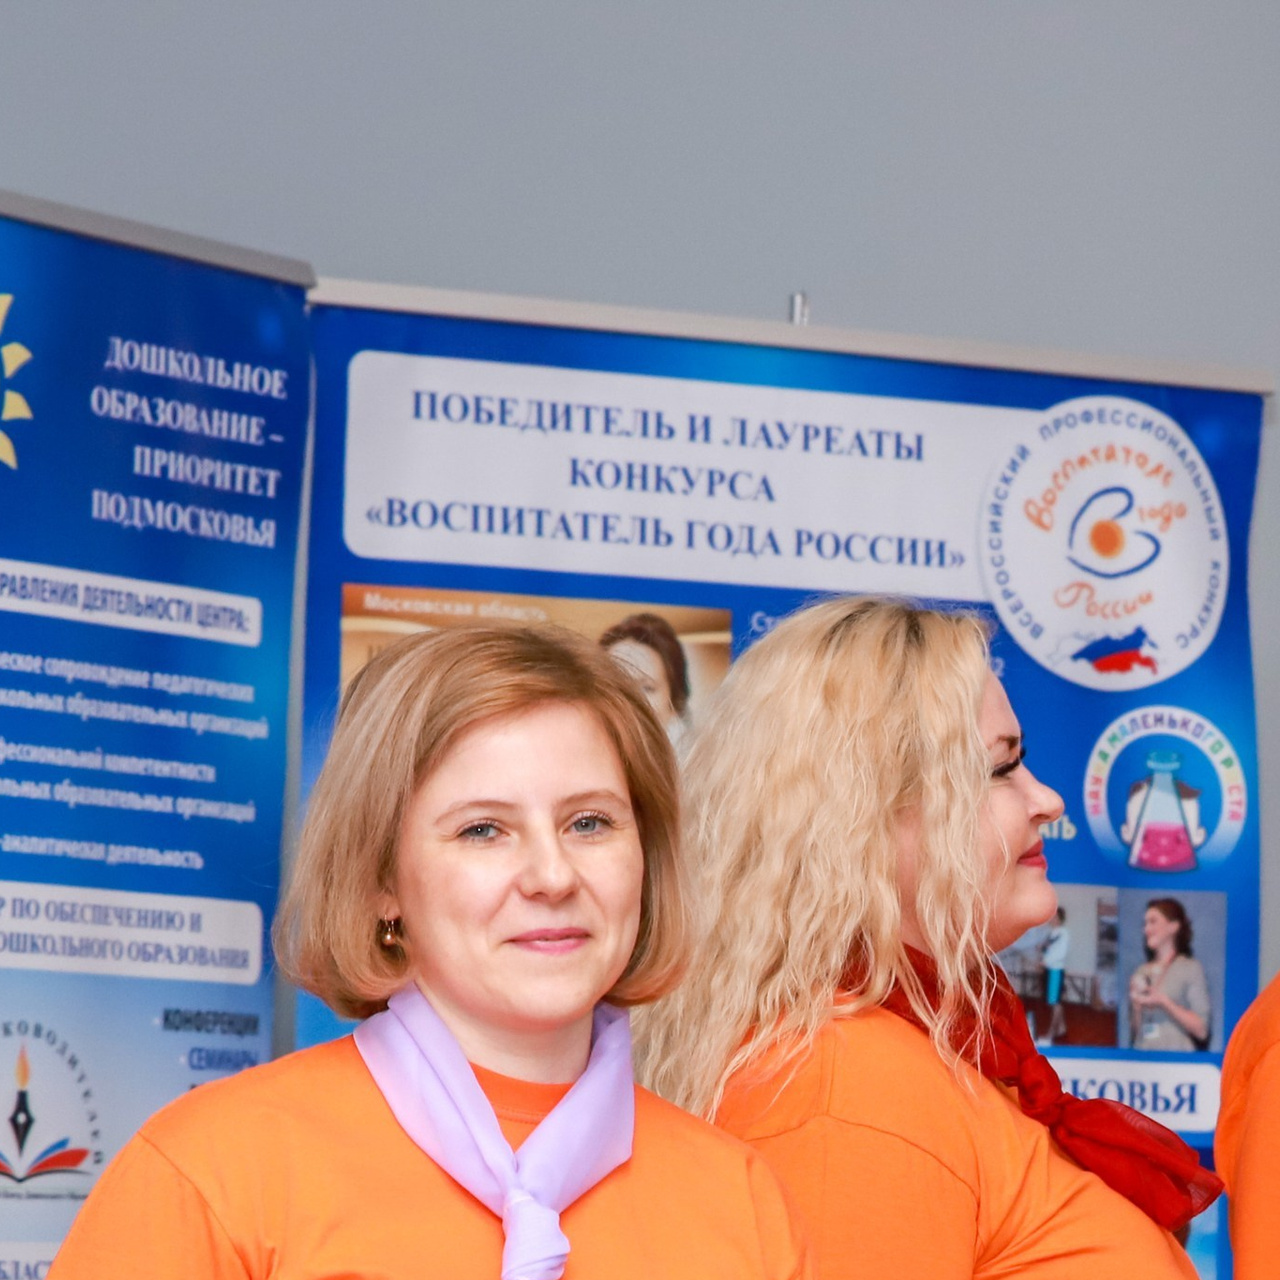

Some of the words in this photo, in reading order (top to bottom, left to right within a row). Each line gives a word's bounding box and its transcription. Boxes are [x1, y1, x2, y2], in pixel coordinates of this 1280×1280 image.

[104, 335, 288, 399] ДОШКОЛЬНОЕ
[90, 386, 265, 446] ОБРАЗОВАНИЕ
[411, 389, 676, 441] ПОБЕДИТЕЛЬ
[687, 413, 711, 445] И
[722, 416, 925, 463] ЛАУРЕАТЫ
[133, 444, 282, 499] ПРИОРИТЕТ
[569, 456, 776, 503] КОНКУРСА
[91, 489, 277, 549] ПОДМОСКОВЬЯ
[365, 496, 675, 548] «ВОСПИТАТЕЛЬ
[685, 519, 783, 558] ГОДА
[795, 528, 966, 570] РОССИИ»
[988, 443, 1046, 641] ВСЕРОССИЙСКИЙ
[1038, 405, 1222, 542] ПРОФЕССИОНАЛЬНЫЙ
[1175, 560, 1222, 650] КОНКУРС
[81, 584, 193, 624] ДЕЯТЕЛЬНОСТИ
[1054, 581, 1154, 620] России
[1106, 711, 1225, 754] МАЛЕНЬКОГО
[11, 897, 41, 921] ПО
[44, 900, 186, 932] ОБЕСПЕЧЕНИЮ
[189, 912, 203, 933] И
[1066, 1077, 1197, 1114] КОВЬЯ
